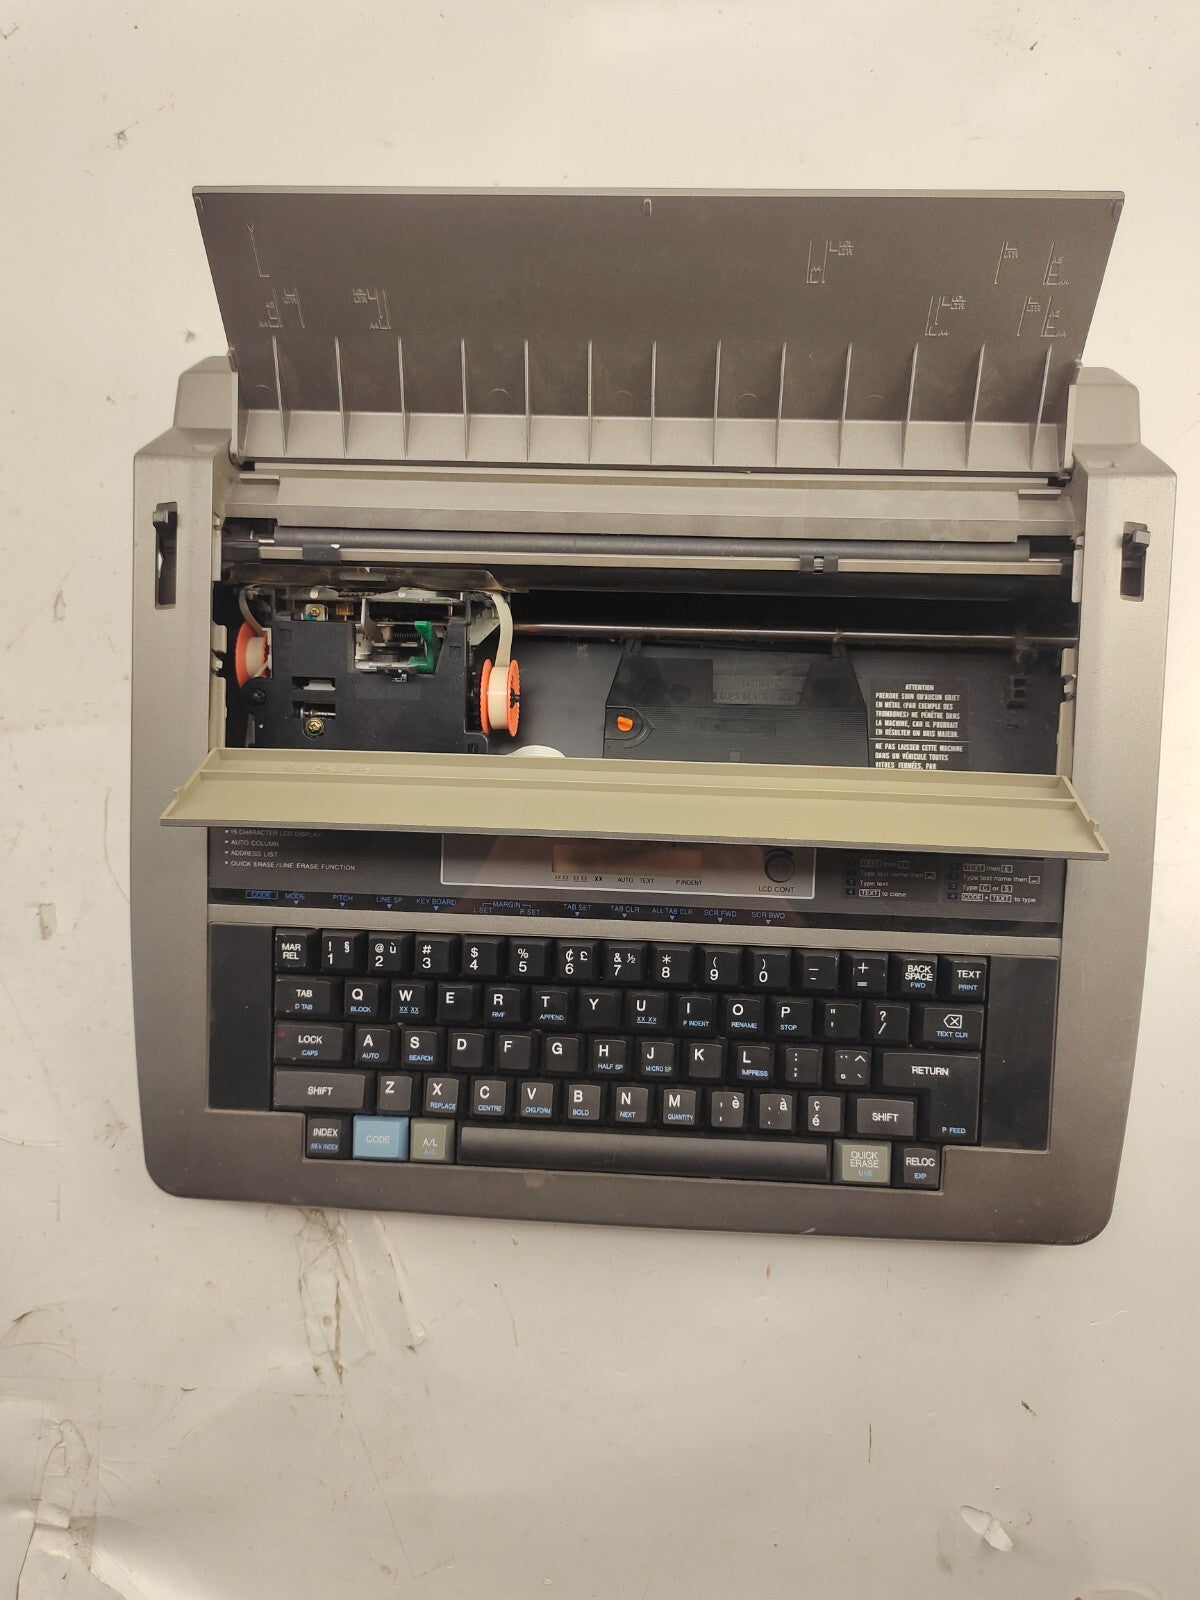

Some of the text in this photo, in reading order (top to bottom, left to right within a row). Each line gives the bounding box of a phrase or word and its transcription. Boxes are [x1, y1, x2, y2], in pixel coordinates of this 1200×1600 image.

[876, 692, 900, 700] PRENDRE
[911, 711, 919, 719] NE
[875, 719, 882, 727] LA
[875, 728, 883, 736] EN
[884, 743, 896, 751] PAS
[897, 743, 920, 751] LAISSER
[921, 744, 938, 752] CETTE
[939, 745, 964, 753] MACHINE
[928, 754, 949, 762] TOUTES
[239, 830, 278, 838] CHARACTER
[231, 839, 250, 847] AUTO
[231, 849, 262, 857] ADDRESS
[230, 860, 252, 868] QUICK
[321, 864, 357, 872] FUNCTION
[1013, 875, 1028, 883] then
[774, 886, 795, 894] CONT
[332, 894, 353, 902] PITCH
[432, 898, 457, 906] BOARD
[1022, 896, 1037, 904] type
[704, 909, 718, 917] SCR
[751, 911, 766, 919] SCR
[281, 943, 301, 951] MAR
[282, 952, 300, 960] REL
[327, 953, 333, 965] 1
[376, 956, 384, 967] 2
[422, 957, 431, 969] 3
[469, 959, 478, 971] 4
[518, 961, 527, 972] 5
[565, 963, 574, 974] 6
[613, 964, 622, 976] 7
[661, 966, 671, 979] 8
[907, 964, 932, 974] BACK
[710, 969, 719, 981] 9
[758, 971, 768, 983] 0
[904, 972, 934, 982] SPACE
[957, 970, 982, 979] TEXT
[910, 981, 926, 989] FWD
[958, 984, 978, 992] PRINT
[296, 988, 313, 998] TAB
[351, 988, 363, 1001] Q
[399, 990, 413, 1002] W
[445, 992, 455, 1004] E
[493, 993, 504, 1006] R
[541, 996, 551, 1008] T
[589, 998, 599, 1010] Y
[350, 1004, 372, 1013] BLOCK
[636, 1000, 646, 1012] U
[686, 1002, 690, 1014] I
[732, 1003, 744, 1016] O
[781, 1006, 791, 1018] P
[688, 1020, 710, 1028] INDENT
[731, 1021, 758, 1030] RENAME
[780, 1024, 797, 1032] STOP
[297, 1035, 322, 1045] LOCK
[936, 1031, 954, 1039] TEXT
[363, 1034, 374, 1047] A
[409, 1036, 420, 1049] S
[456, 1039, 467, 1051] D
[503, 1041, 513, 1053] F
[551, 1042, 563, 1055] G
[598, 1045, 609, 1057] H
[408, 1054, 434, 1062] SEARCH
[646, 1047, 655, 1060] J
[694, 1049, 705, 1061] K
[742, 1051, 752, 1064] L
[741, 1070, 769, 1078] IMPRESS
[911, 1066, 949, 1076] RETURN
[307, 1086, 334, 1096] SHIFT
[385, 1081, 395, 1094] Z
[432, 1083, 443, 1095] X
[479, 1085, 490, 1098] C
[527, 1088, 537, 1100] V
[573, 1090, 584, 1102] B
[621, 1092, 632, 1105] N
[668, 1094, 681, 1107] M
[430, 1102, 456, 1110] REPLACE
[667, 1114, 694, 1122] QUANTITY
[872, 1112, 899, 1123] SHIFT
[313, 1128, 339, 1138] INDEX
[366, 1134, 391, 1144] CODE
[422, 1137, 438, 1147] A/L
[323, 1143, 339, 1151] INDEX
[850, 1151, 878, 1161] QUICK
[850, 1159, 880, 1169] ERASE
[905, 1157, 936, 1167] RELOC
